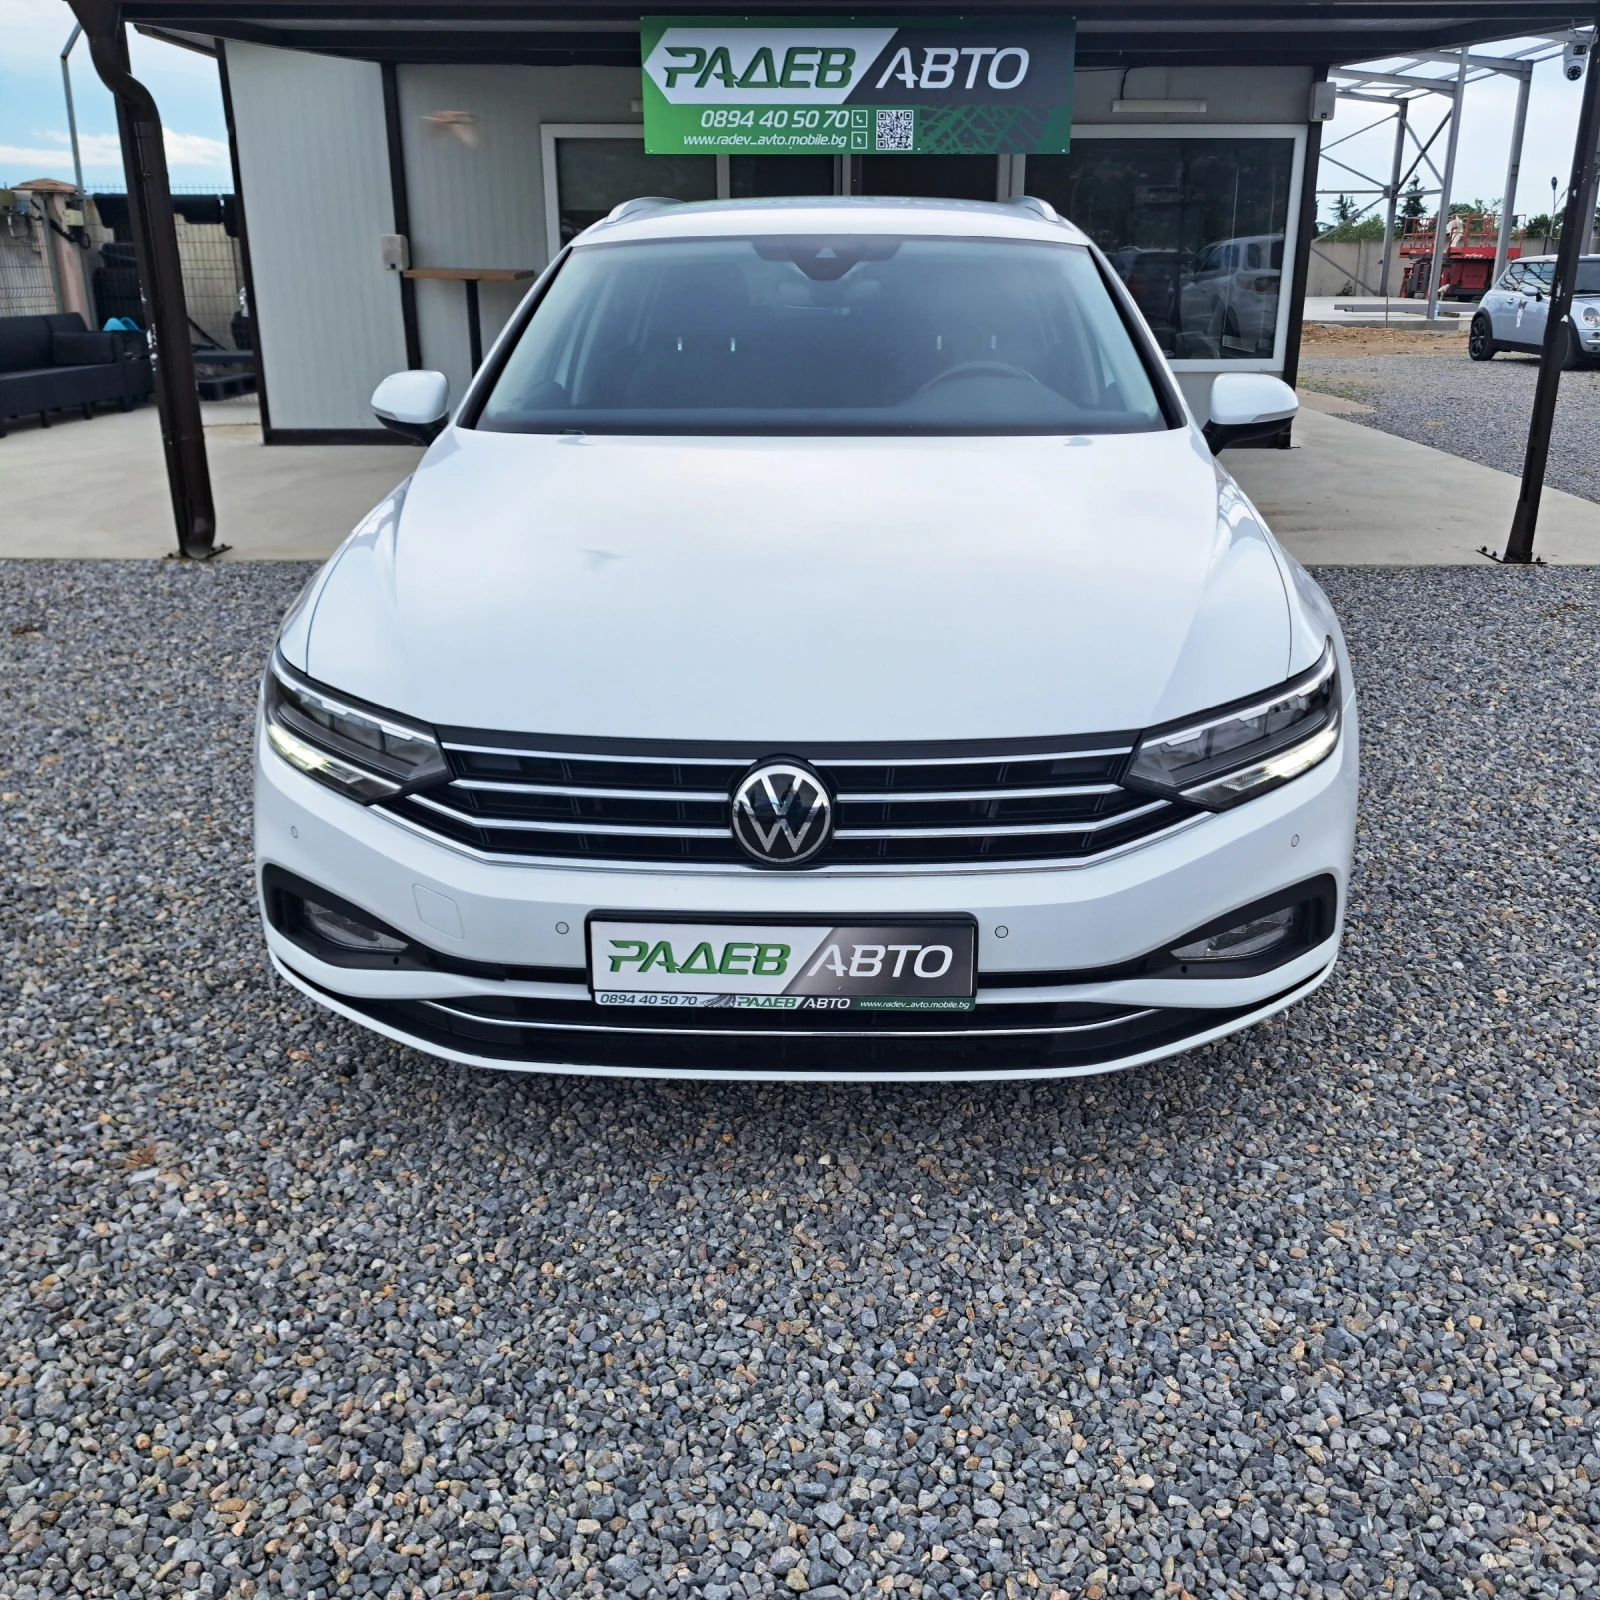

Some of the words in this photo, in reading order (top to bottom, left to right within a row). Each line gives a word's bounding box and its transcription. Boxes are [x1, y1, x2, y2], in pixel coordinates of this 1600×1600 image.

[663, 46, 856, 89] РАДЕВ
[875, 46, 1030, 89] АВТО
[700, 110, 754, 128] 0894
[758, 110, 789, 128] 40
[791, 110, 820, 128] 50
[822, 110, 850, 128] 70
[683, 133, 848, 148] www.radev_avto.mobile.bg
[608, 939, 792, 976] РАДЕВ
[807, 944, 954, 979] АВТО
[600, 994, 636, 1004] 0894
[638, 995, 658, 1005] 40
[659, 996, 679, 1006] 50
[681, 996, 698, 1006] 70
[736, 996, 798, 1008] РАДЕВ
[802, 998, 851, 1010] АВТО
[859, 1000, 970, 1010] www.radev_avto.mobile.bg
